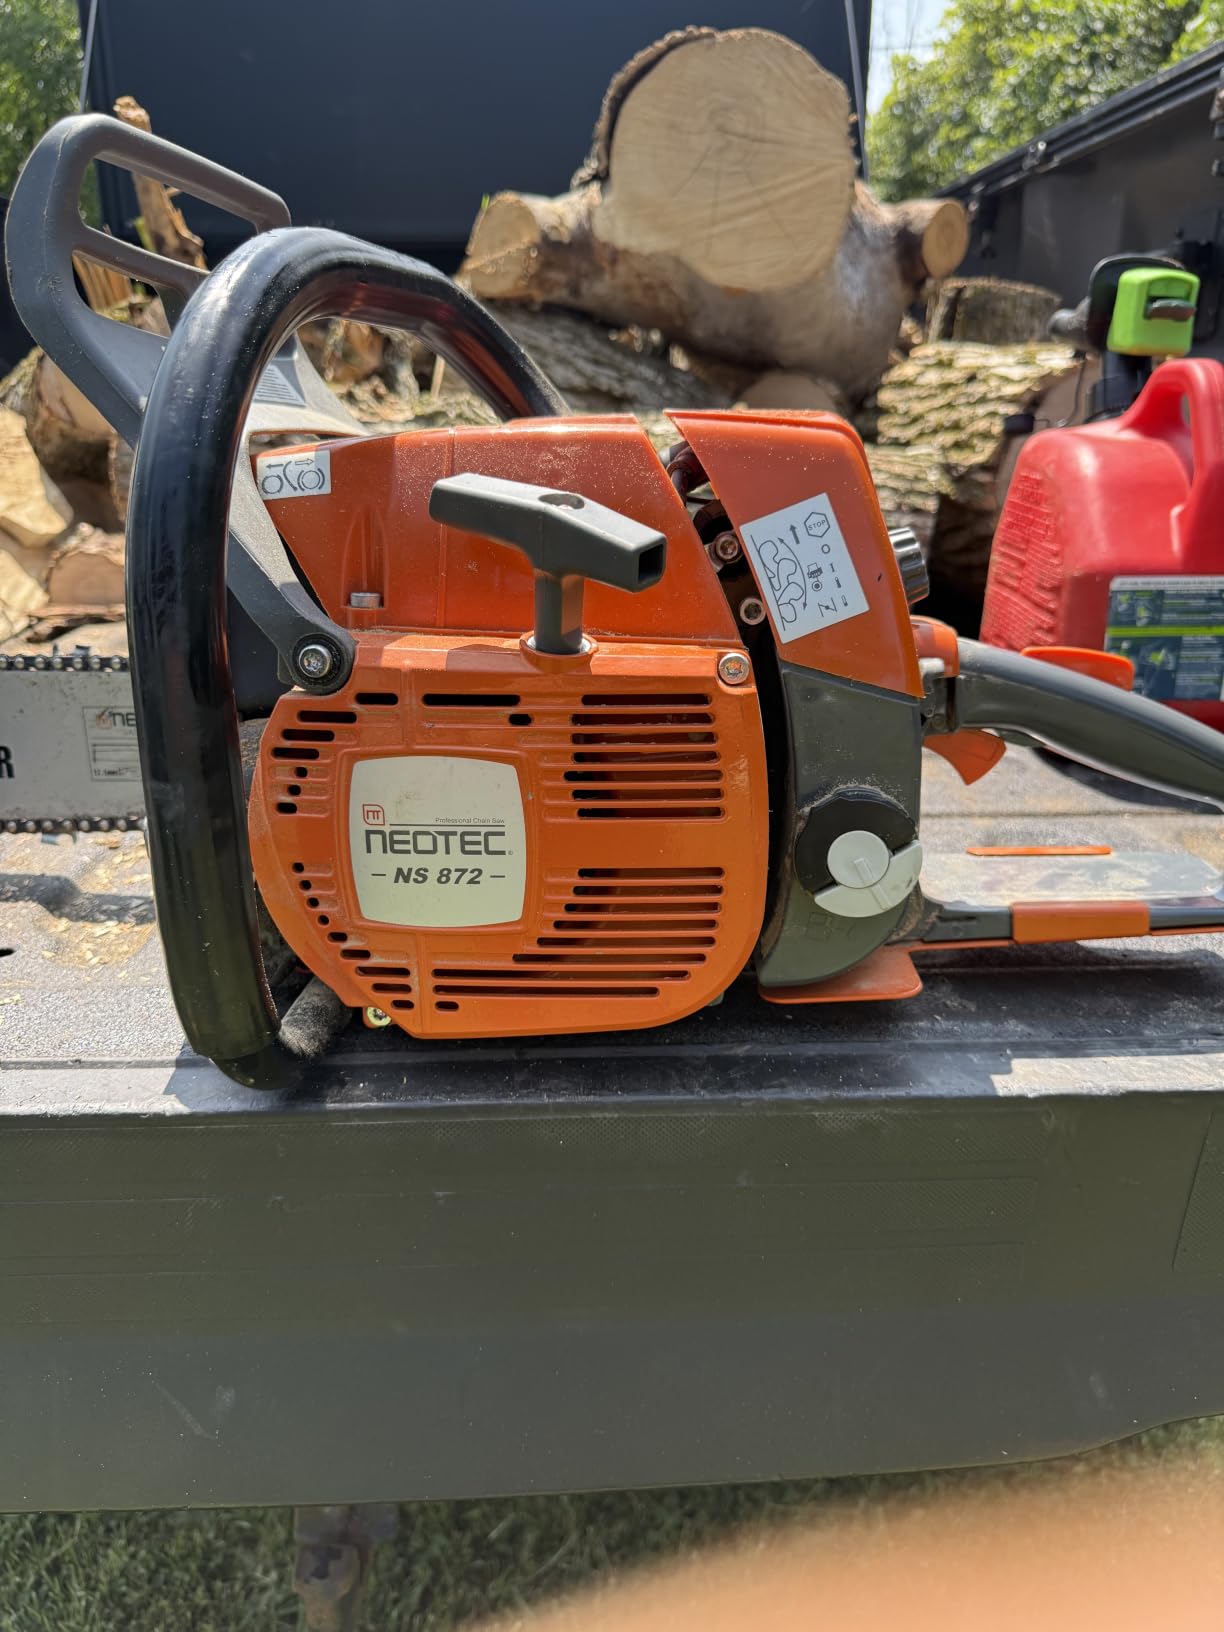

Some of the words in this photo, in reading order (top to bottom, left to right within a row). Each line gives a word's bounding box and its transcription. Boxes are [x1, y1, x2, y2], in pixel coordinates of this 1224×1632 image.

[808, 520, 826, 530] STOP
[365, 829, 506, 855] NEOTEC
[393, 867, 429, 884] NS
[436, 867, 484, 885] 872
